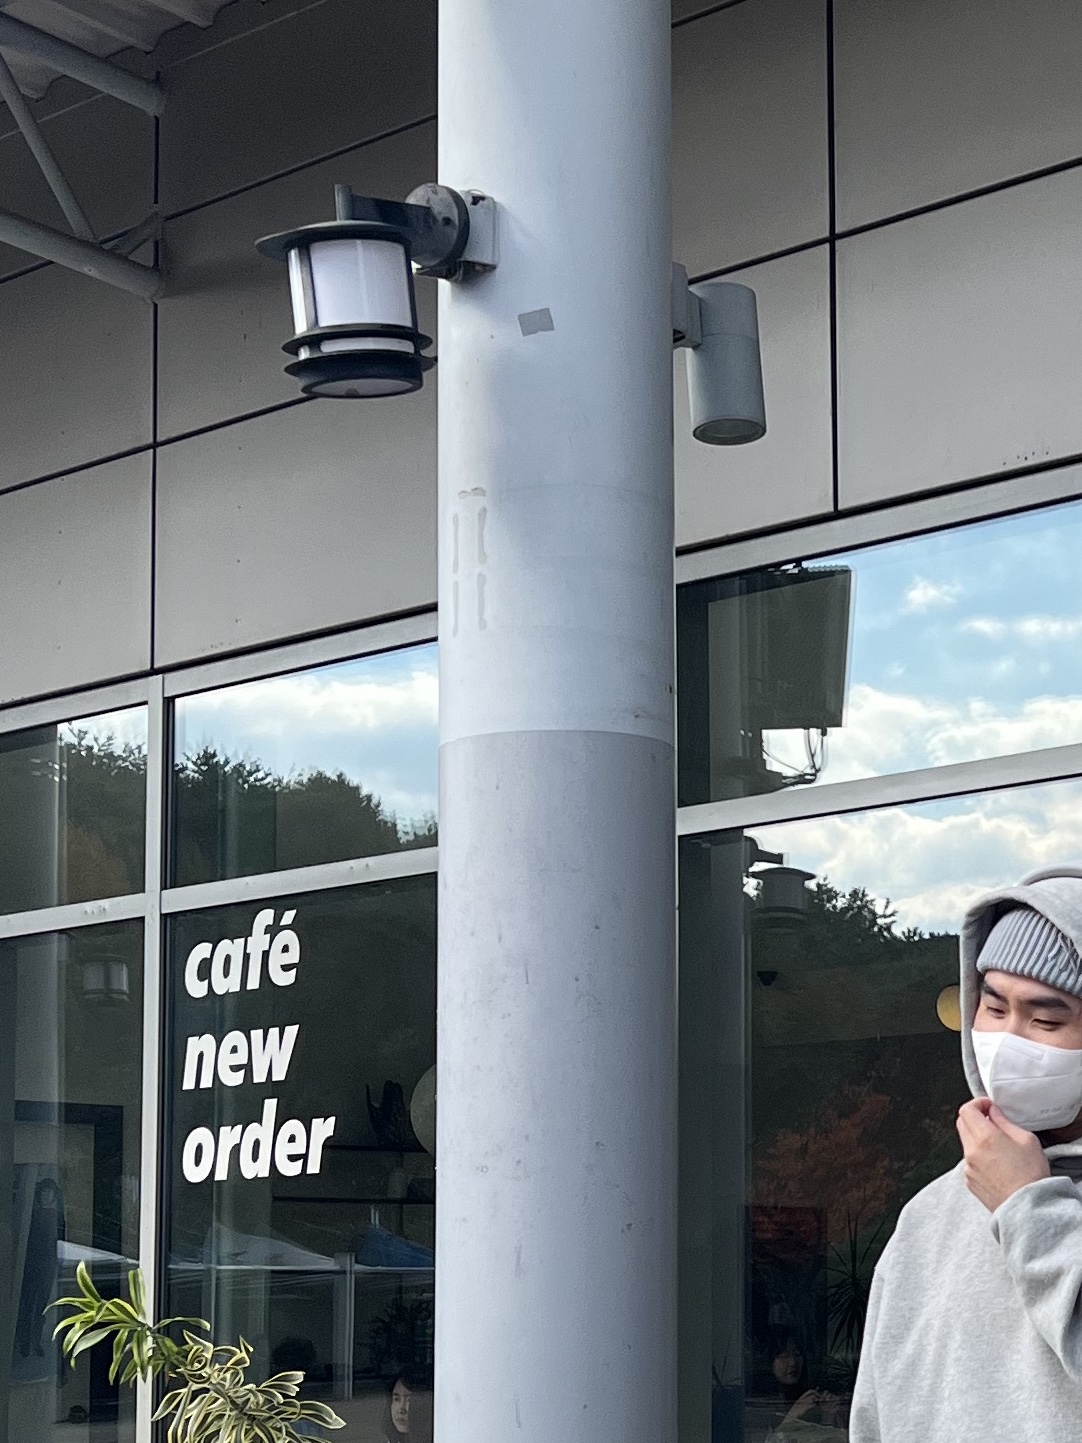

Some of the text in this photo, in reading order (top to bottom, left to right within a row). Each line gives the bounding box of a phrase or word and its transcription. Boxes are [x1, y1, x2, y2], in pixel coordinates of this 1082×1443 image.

[184, 908, 300, 998] café
[182, 1024, 299, 1090] new
[182, 1098, 336, 1183] order
